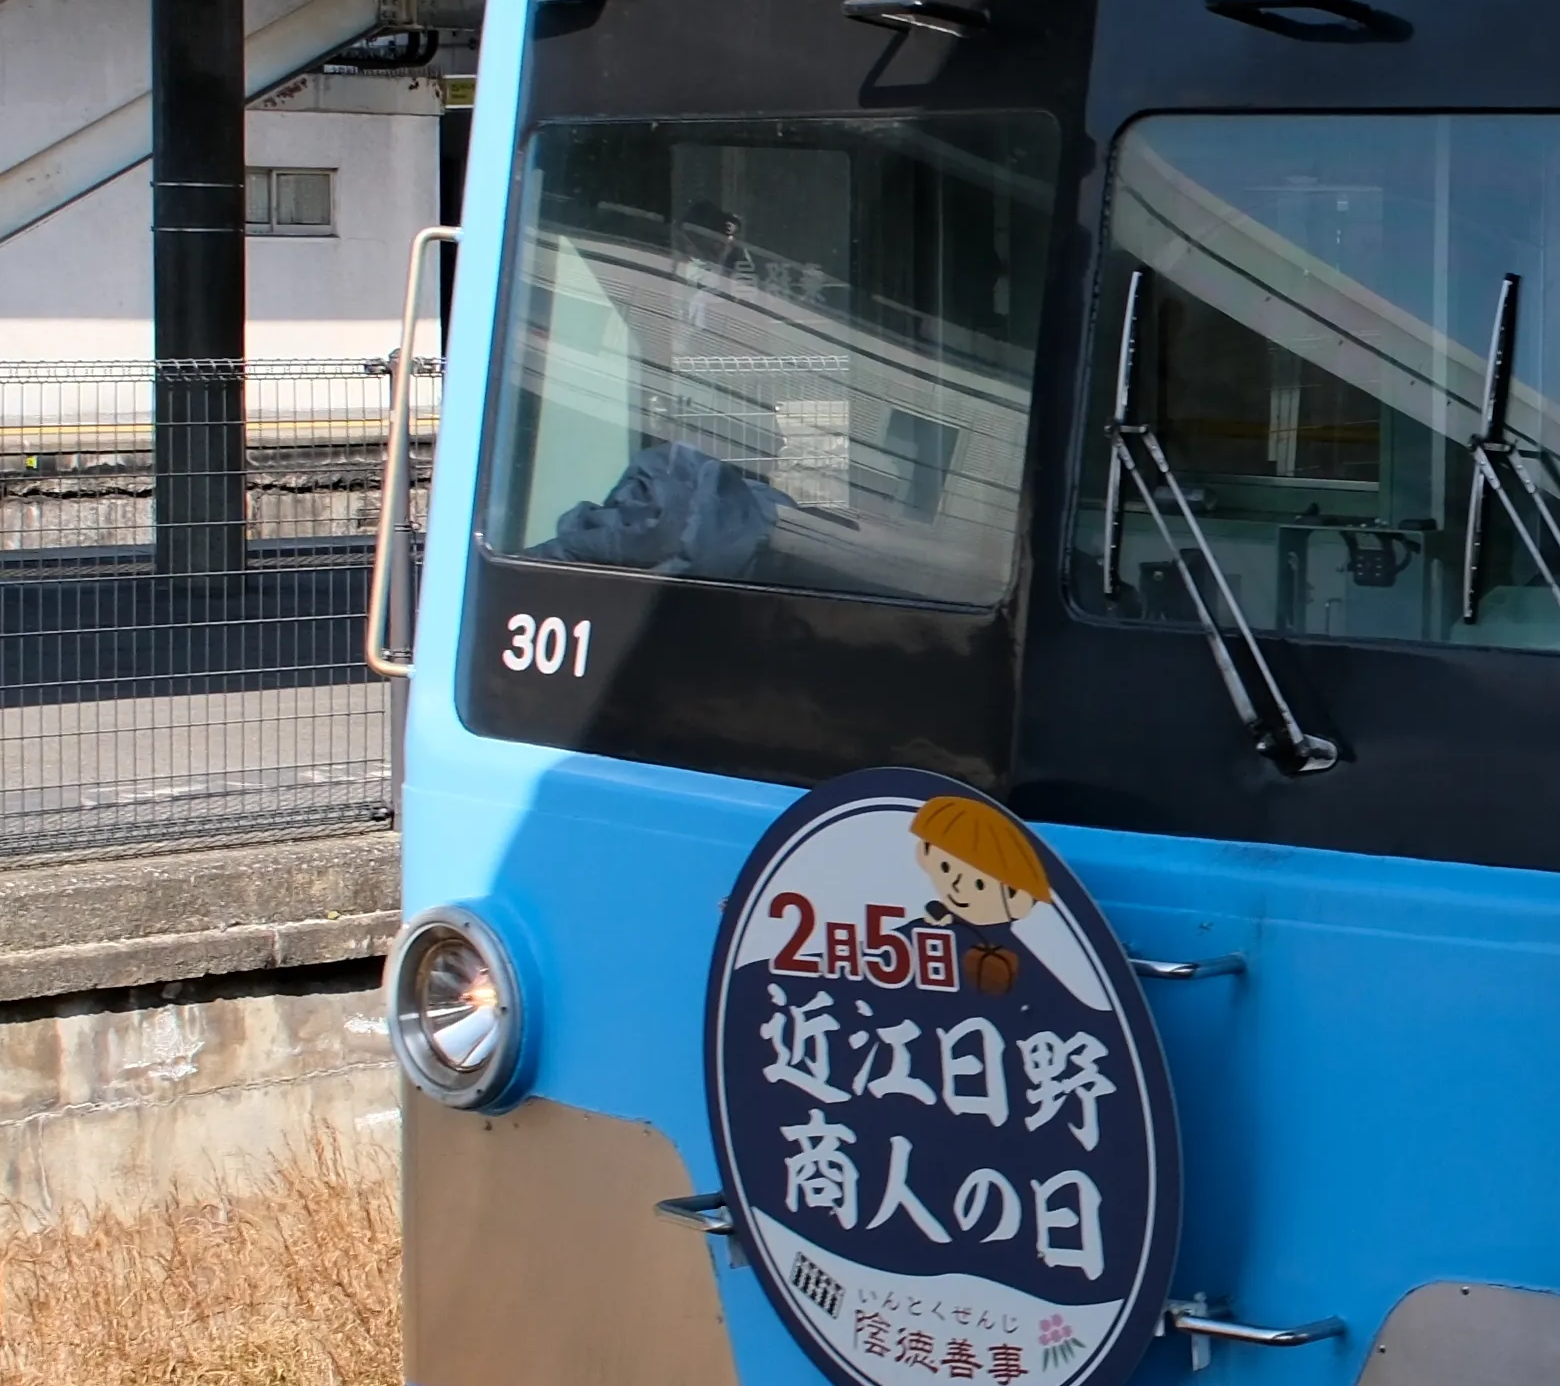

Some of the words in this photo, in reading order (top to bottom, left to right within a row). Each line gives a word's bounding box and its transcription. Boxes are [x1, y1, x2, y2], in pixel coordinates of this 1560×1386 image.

[502, 613, 591, 677] 301
[768, 892, 959, 992] 2月5日
[760, 984, 1117, 1152] 近江日野
[782, 1110, 1104, 1281] 商人の日
[853, 1309, 1030, 1386] 陰徳善事
[857, 1288, 1020, 1334] いんとくぜんじ
